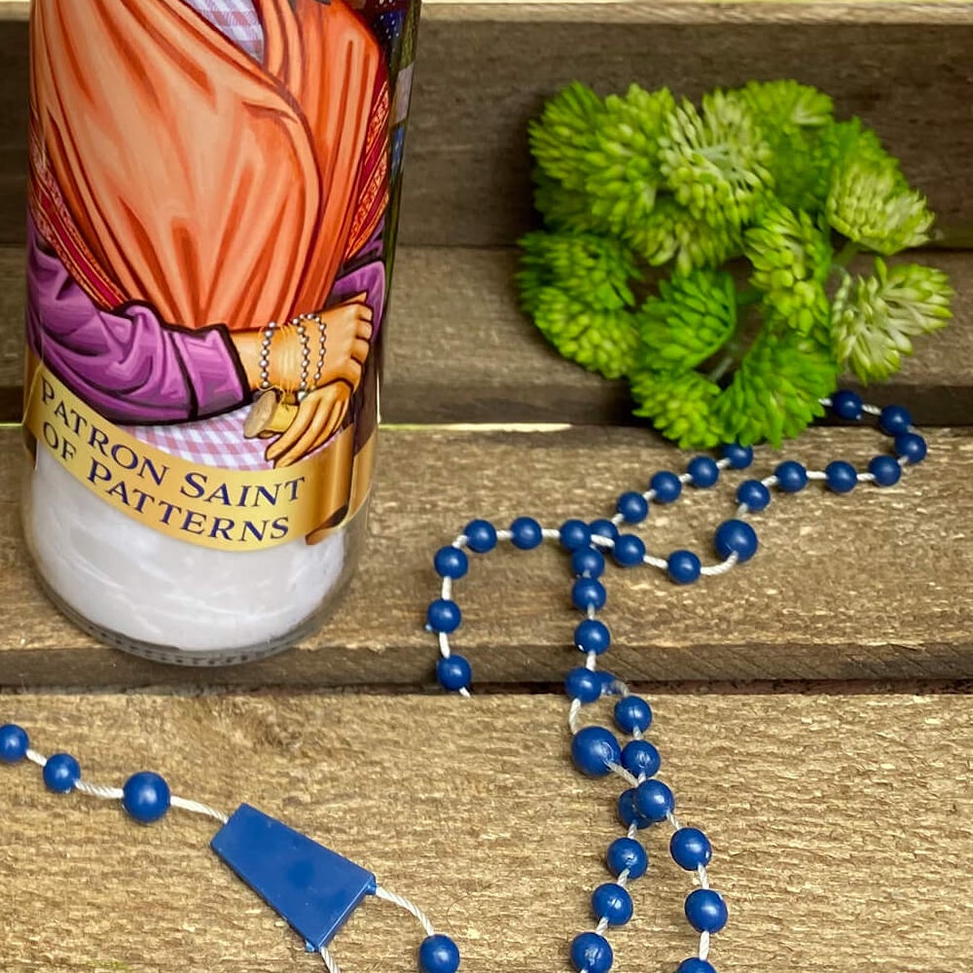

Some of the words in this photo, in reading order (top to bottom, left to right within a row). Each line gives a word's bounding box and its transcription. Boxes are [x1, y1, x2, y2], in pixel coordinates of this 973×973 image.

[40, 374, 170, 486] PATRON
[180, 472, 306, 508] SAINT
[42, 421, 77, 461] OF
[87, 458, 290, 542] PATTERNS
